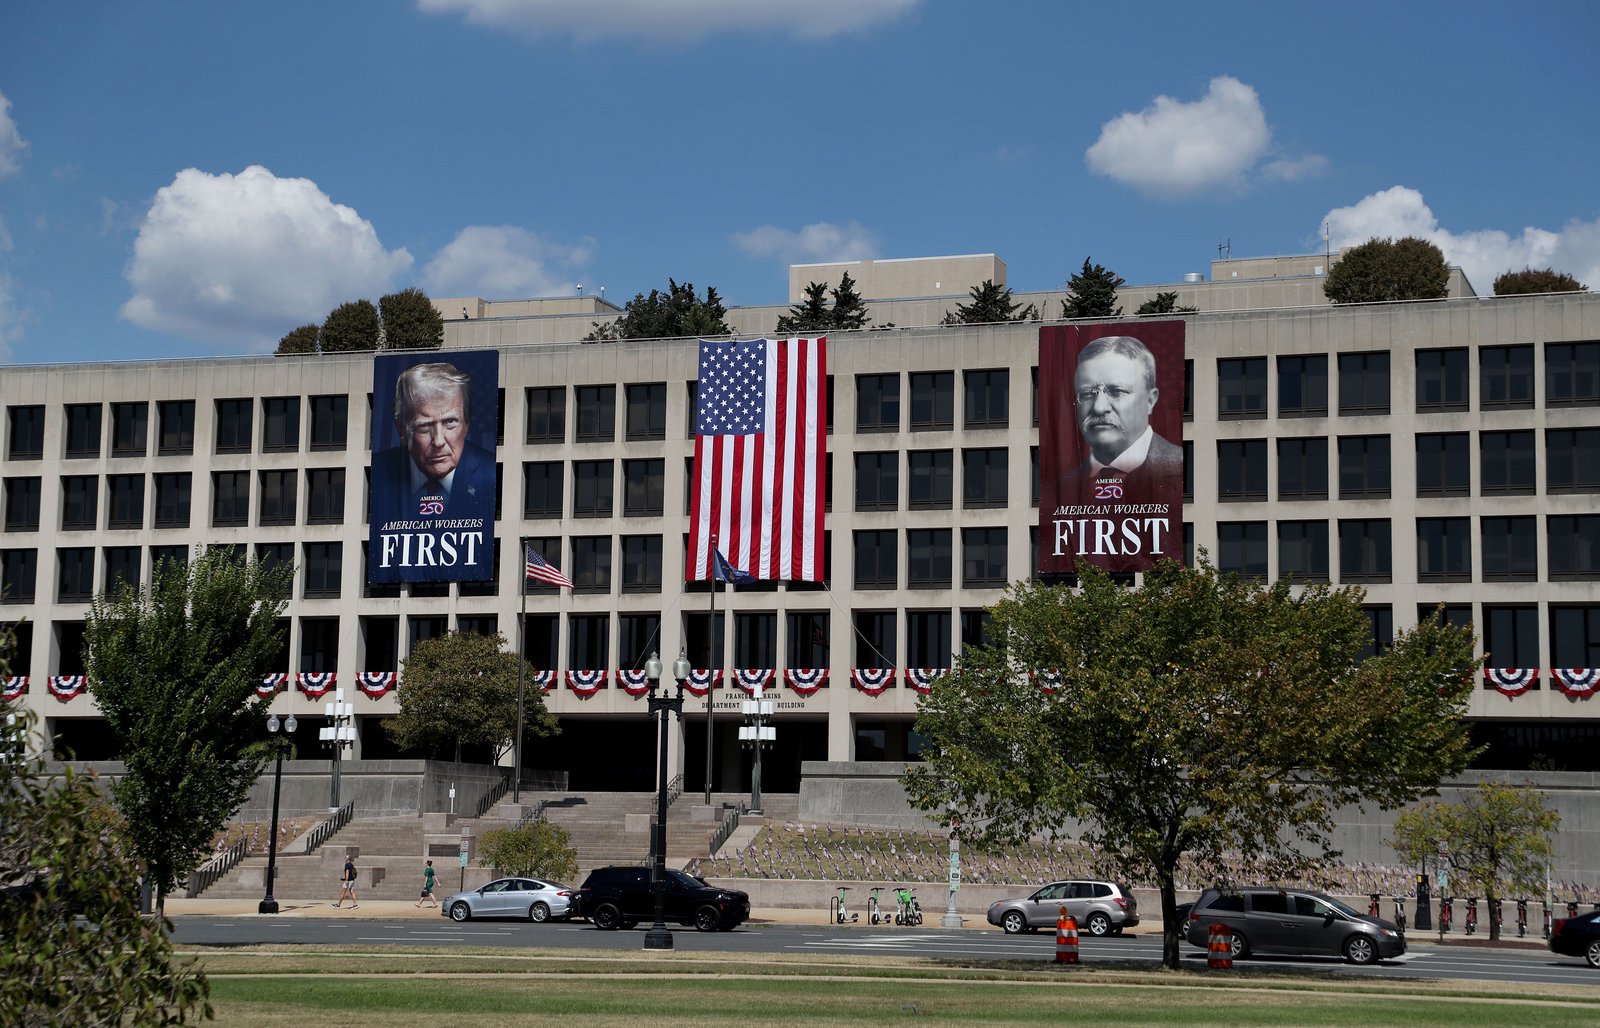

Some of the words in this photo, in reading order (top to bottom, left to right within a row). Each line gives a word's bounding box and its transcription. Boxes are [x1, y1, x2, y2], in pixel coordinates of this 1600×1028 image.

[1095, 485, 1124, 499] 250
[419, 502, 444, 515] 250
[1053, 504, 1111, 516] AMERICAN
[1113, 503, 1169, 514] WORKERS
[381, 519, 432, 531] AMERICAN
[434, 518, 484, 529] WORKERS
[1052, 518, 1169, 556] FIRST
[379, 532, 483, 568] FIRST
